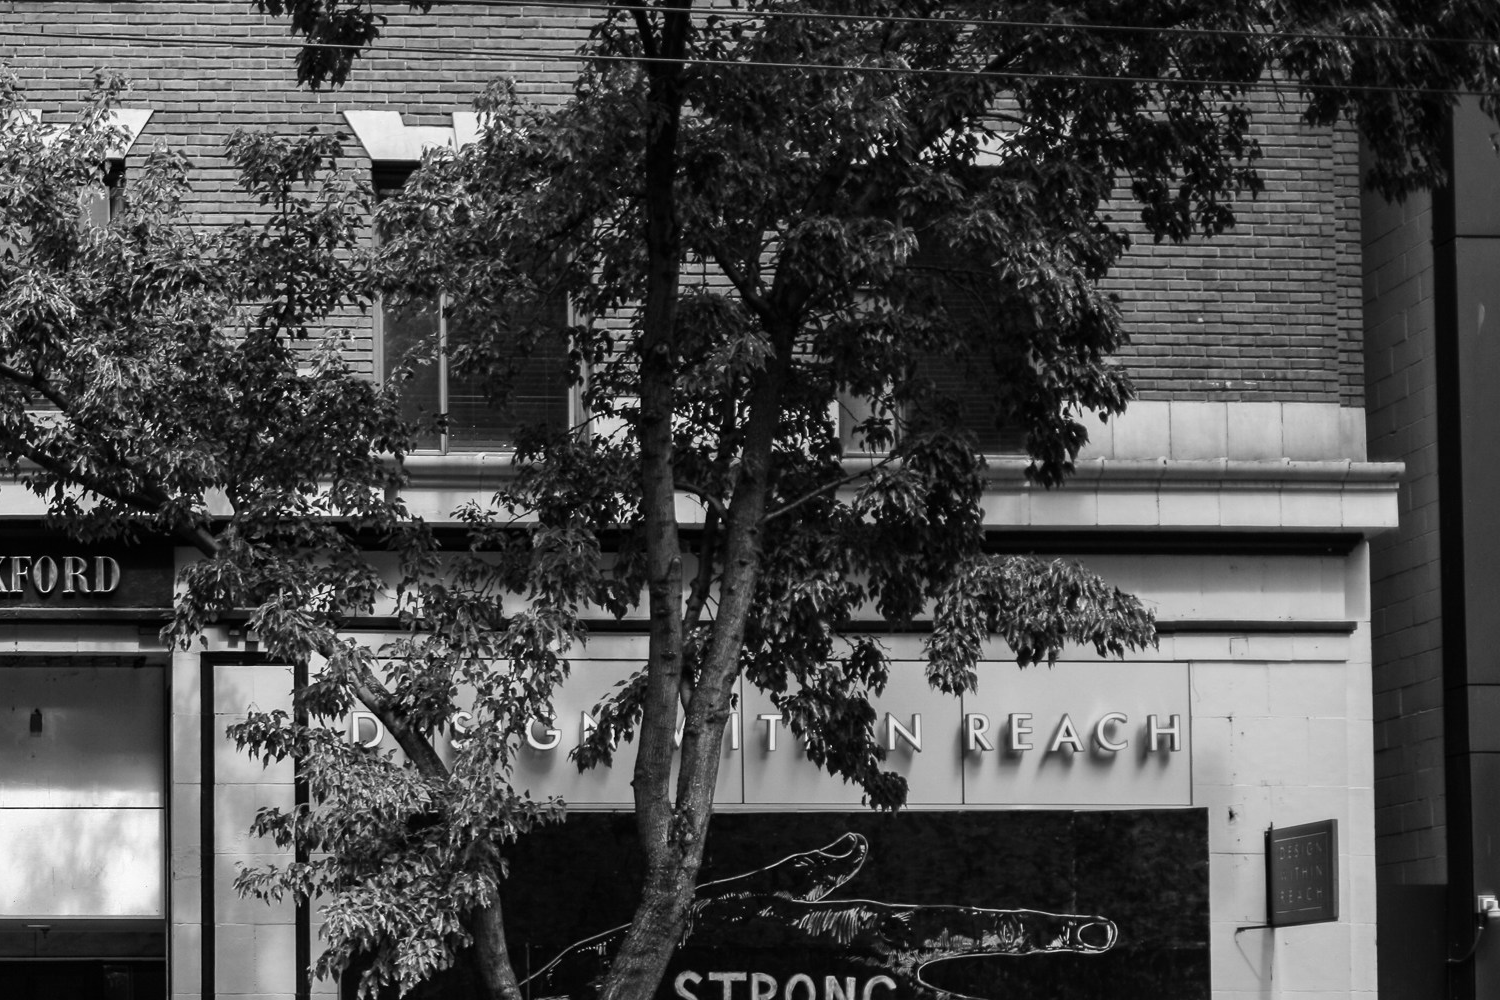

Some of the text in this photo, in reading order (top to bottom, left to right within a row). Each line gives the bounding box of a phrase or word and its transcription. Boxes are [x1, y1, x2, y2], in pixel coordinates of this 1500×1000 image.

[351, 711, 620, 751] DSGN
[964, 712, 1182, 752] REACH
[1279, 841, 1323, 860] DESIGN
[1279, 864, 1323, 881] WITHIN
[1279, 886, 1323, 904] REACH
